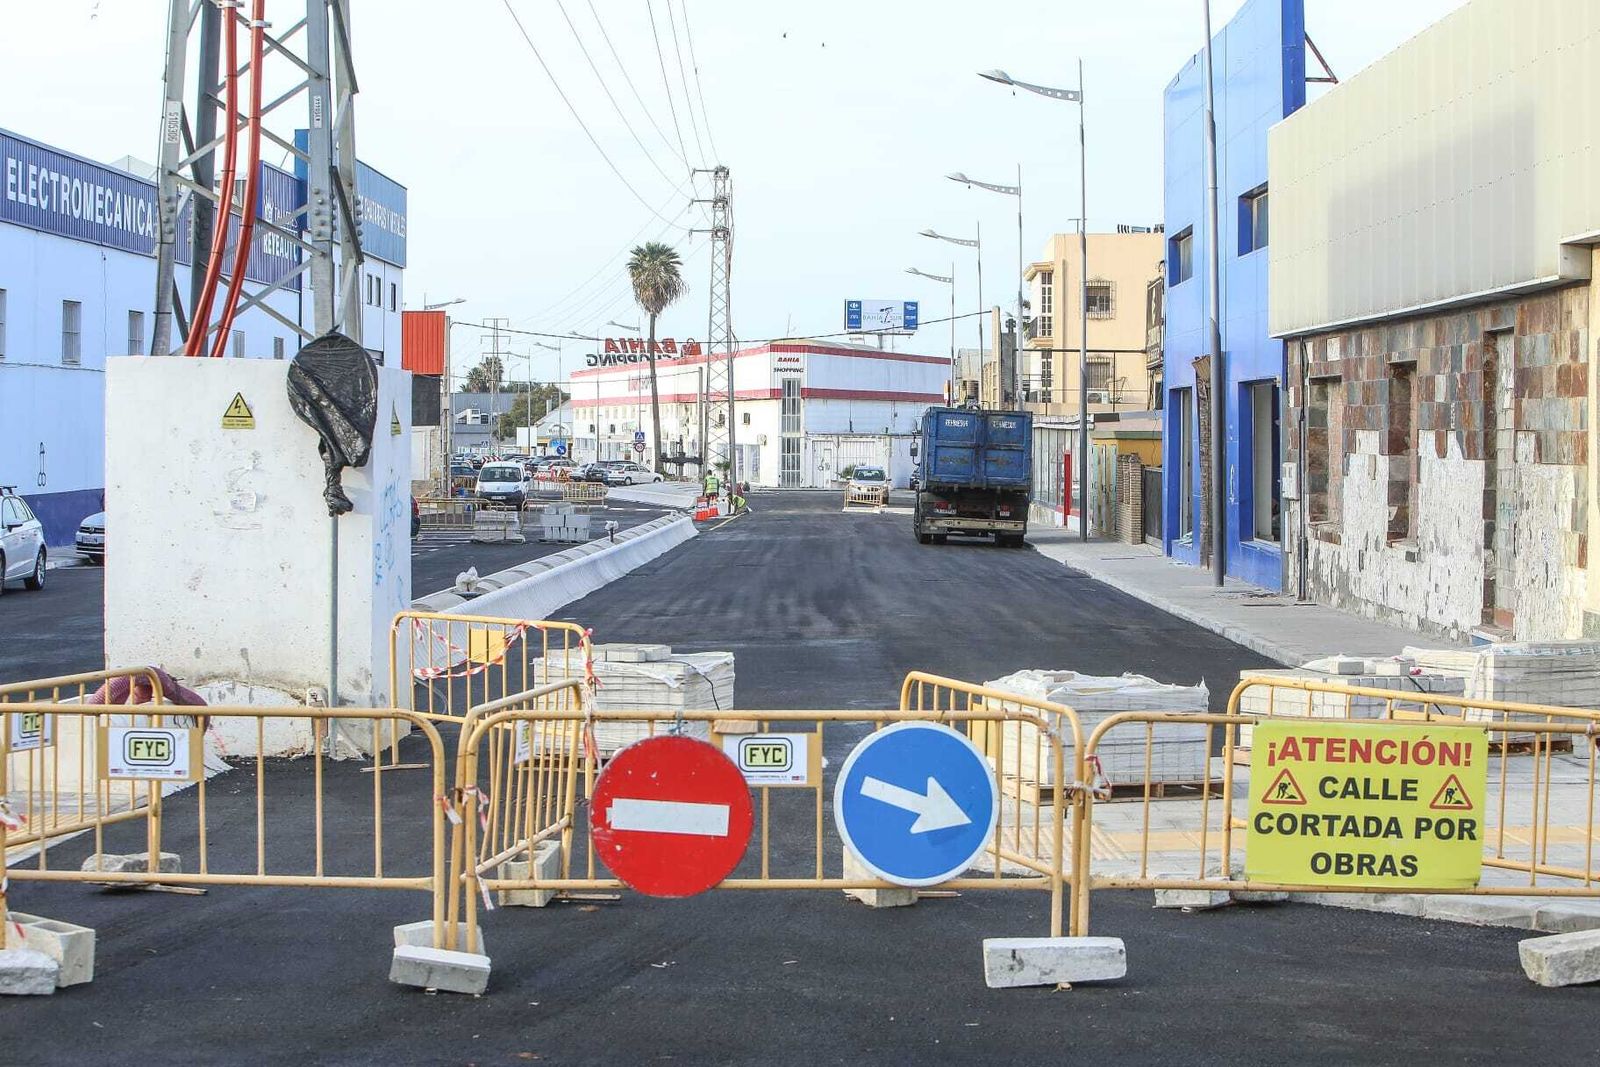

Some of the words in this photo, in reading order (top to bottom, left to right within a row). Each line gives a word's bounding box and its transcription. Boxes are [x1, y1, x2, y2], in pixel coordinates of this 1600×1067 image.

[7, 157, 154, 238] ELECTROMECANICA
[133, 741, 165, 758] FYC
[749, 747, 782, 764] FYC
[1267, 735, 1472, 767] ¡ATENCIÓN!
[1318, 776, 1419, 801] CALLE
[1254, 812, 1403, 839] CORTADA
[1414, 817, 1477, 841] POR
[1310, 852, 1418, 877] OBRAS
